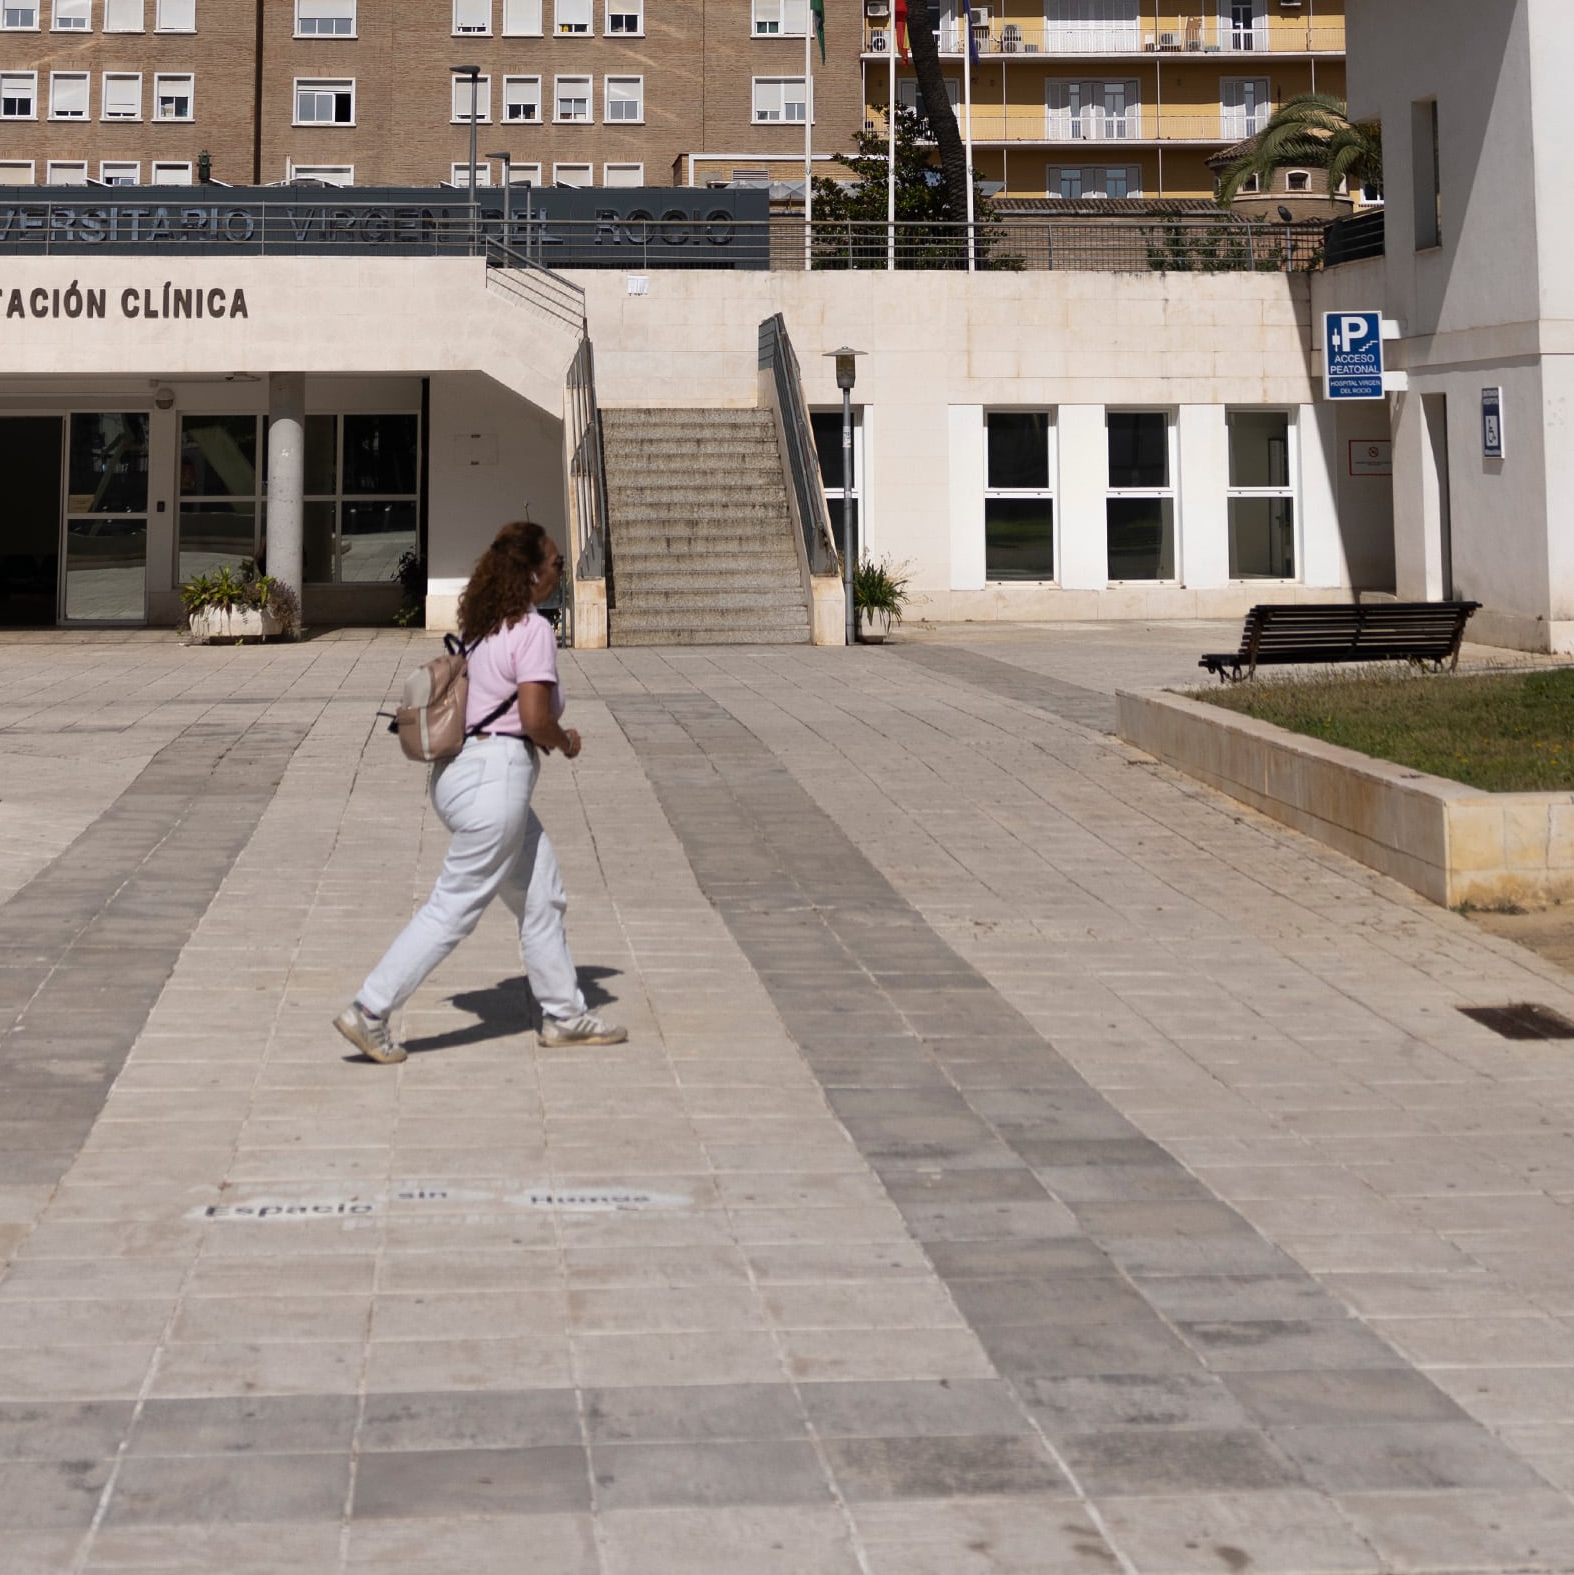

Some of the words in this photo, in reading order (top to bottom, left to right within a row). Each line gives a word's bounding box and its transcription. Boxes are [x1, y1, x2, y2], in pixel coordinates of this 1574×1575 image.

[286, 207, 450, 243] VIRGEN
[479, 207, 563, 245] DEL
[593, 208, 734, 245] ROCIO
[120, 281, 249, 319] CLÍNICA
[1341, 316, 1368, 352] P
[1330, 365, 1379, 374] PEATONAL
[1334, 354, 1375, 363] ACCESO
[205, 1203, 373, 1218] Espacio
